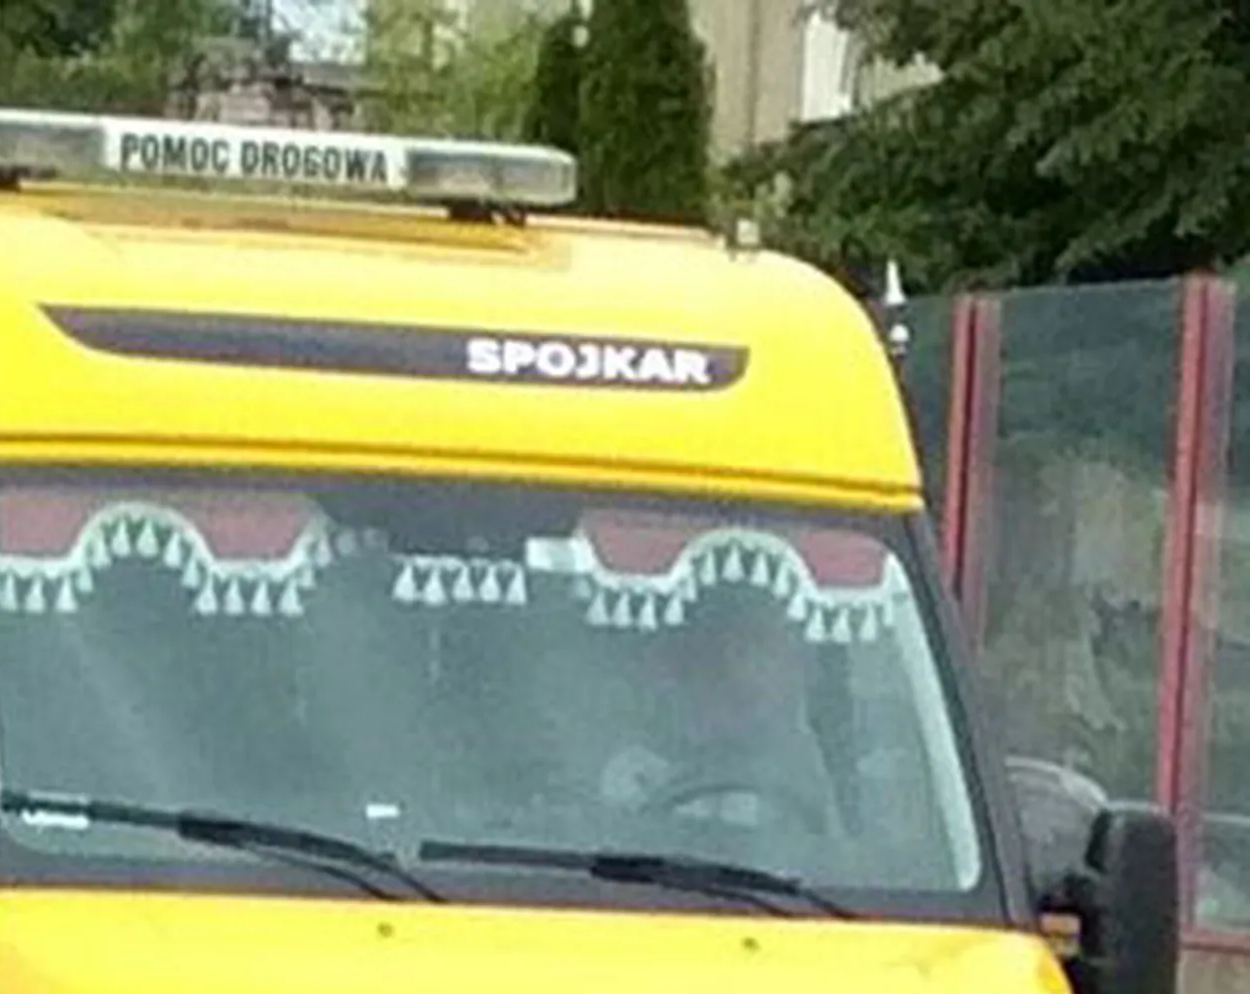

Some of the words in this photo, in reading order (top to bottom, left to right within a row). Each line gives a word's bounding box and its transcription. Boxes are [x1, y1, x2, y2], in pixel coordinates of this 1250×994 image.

[120, 132, 230, 174] POMOC
[240, 140, 388, 182] DROGOWA
[466, 337, 711, 383] SPOJKAR
